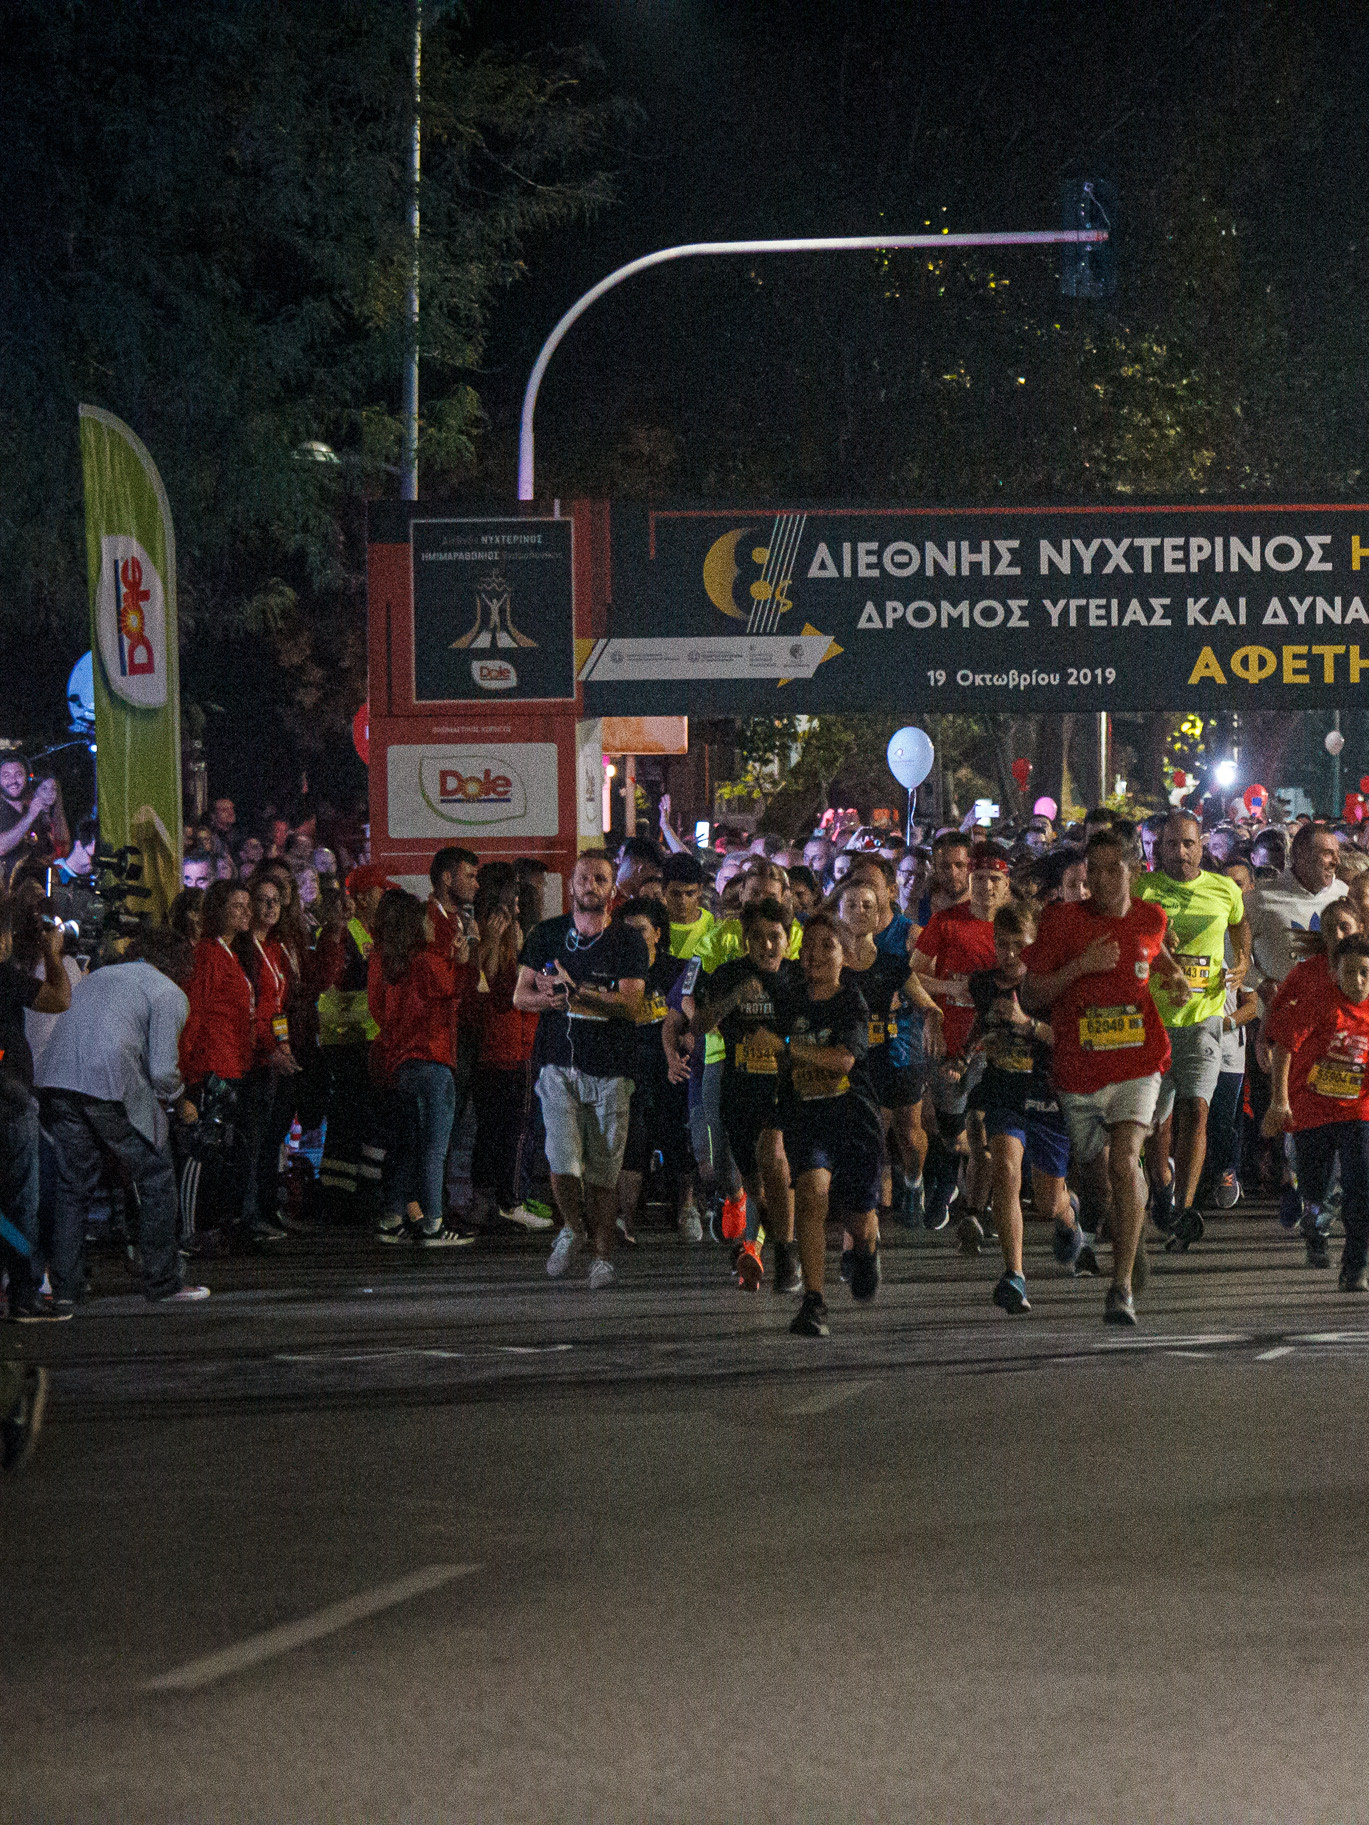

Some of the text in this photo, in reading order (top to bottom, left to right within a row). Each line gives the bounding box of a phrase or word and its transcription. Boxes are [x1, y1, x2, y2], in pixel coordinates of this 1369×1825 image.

[481, 534, 543, 544] ΝΥΧΤΕΡΙΝΟΣ
[807, 540, 1021, 578] ΔΙΕΘΝΗΣ
[1040, 535, 1333, 576] ΝΥΧΤΕΡΙΝΟΣ
[857, 600, 1029, 629] ΔΡΟΜΟΣ
[1043, 598, 1171, 627] ΥΓΕΙΑΣ
[1187, 597, 1247, 626] ΚΑΙ
[480, 666, 511, 679] Dole
[927, 667, 1116, 690] 19 Οκτωβρίου 2019
[439, 769, 512, 798] Dole
[1025, 1099, 1058, 1112] FILA
